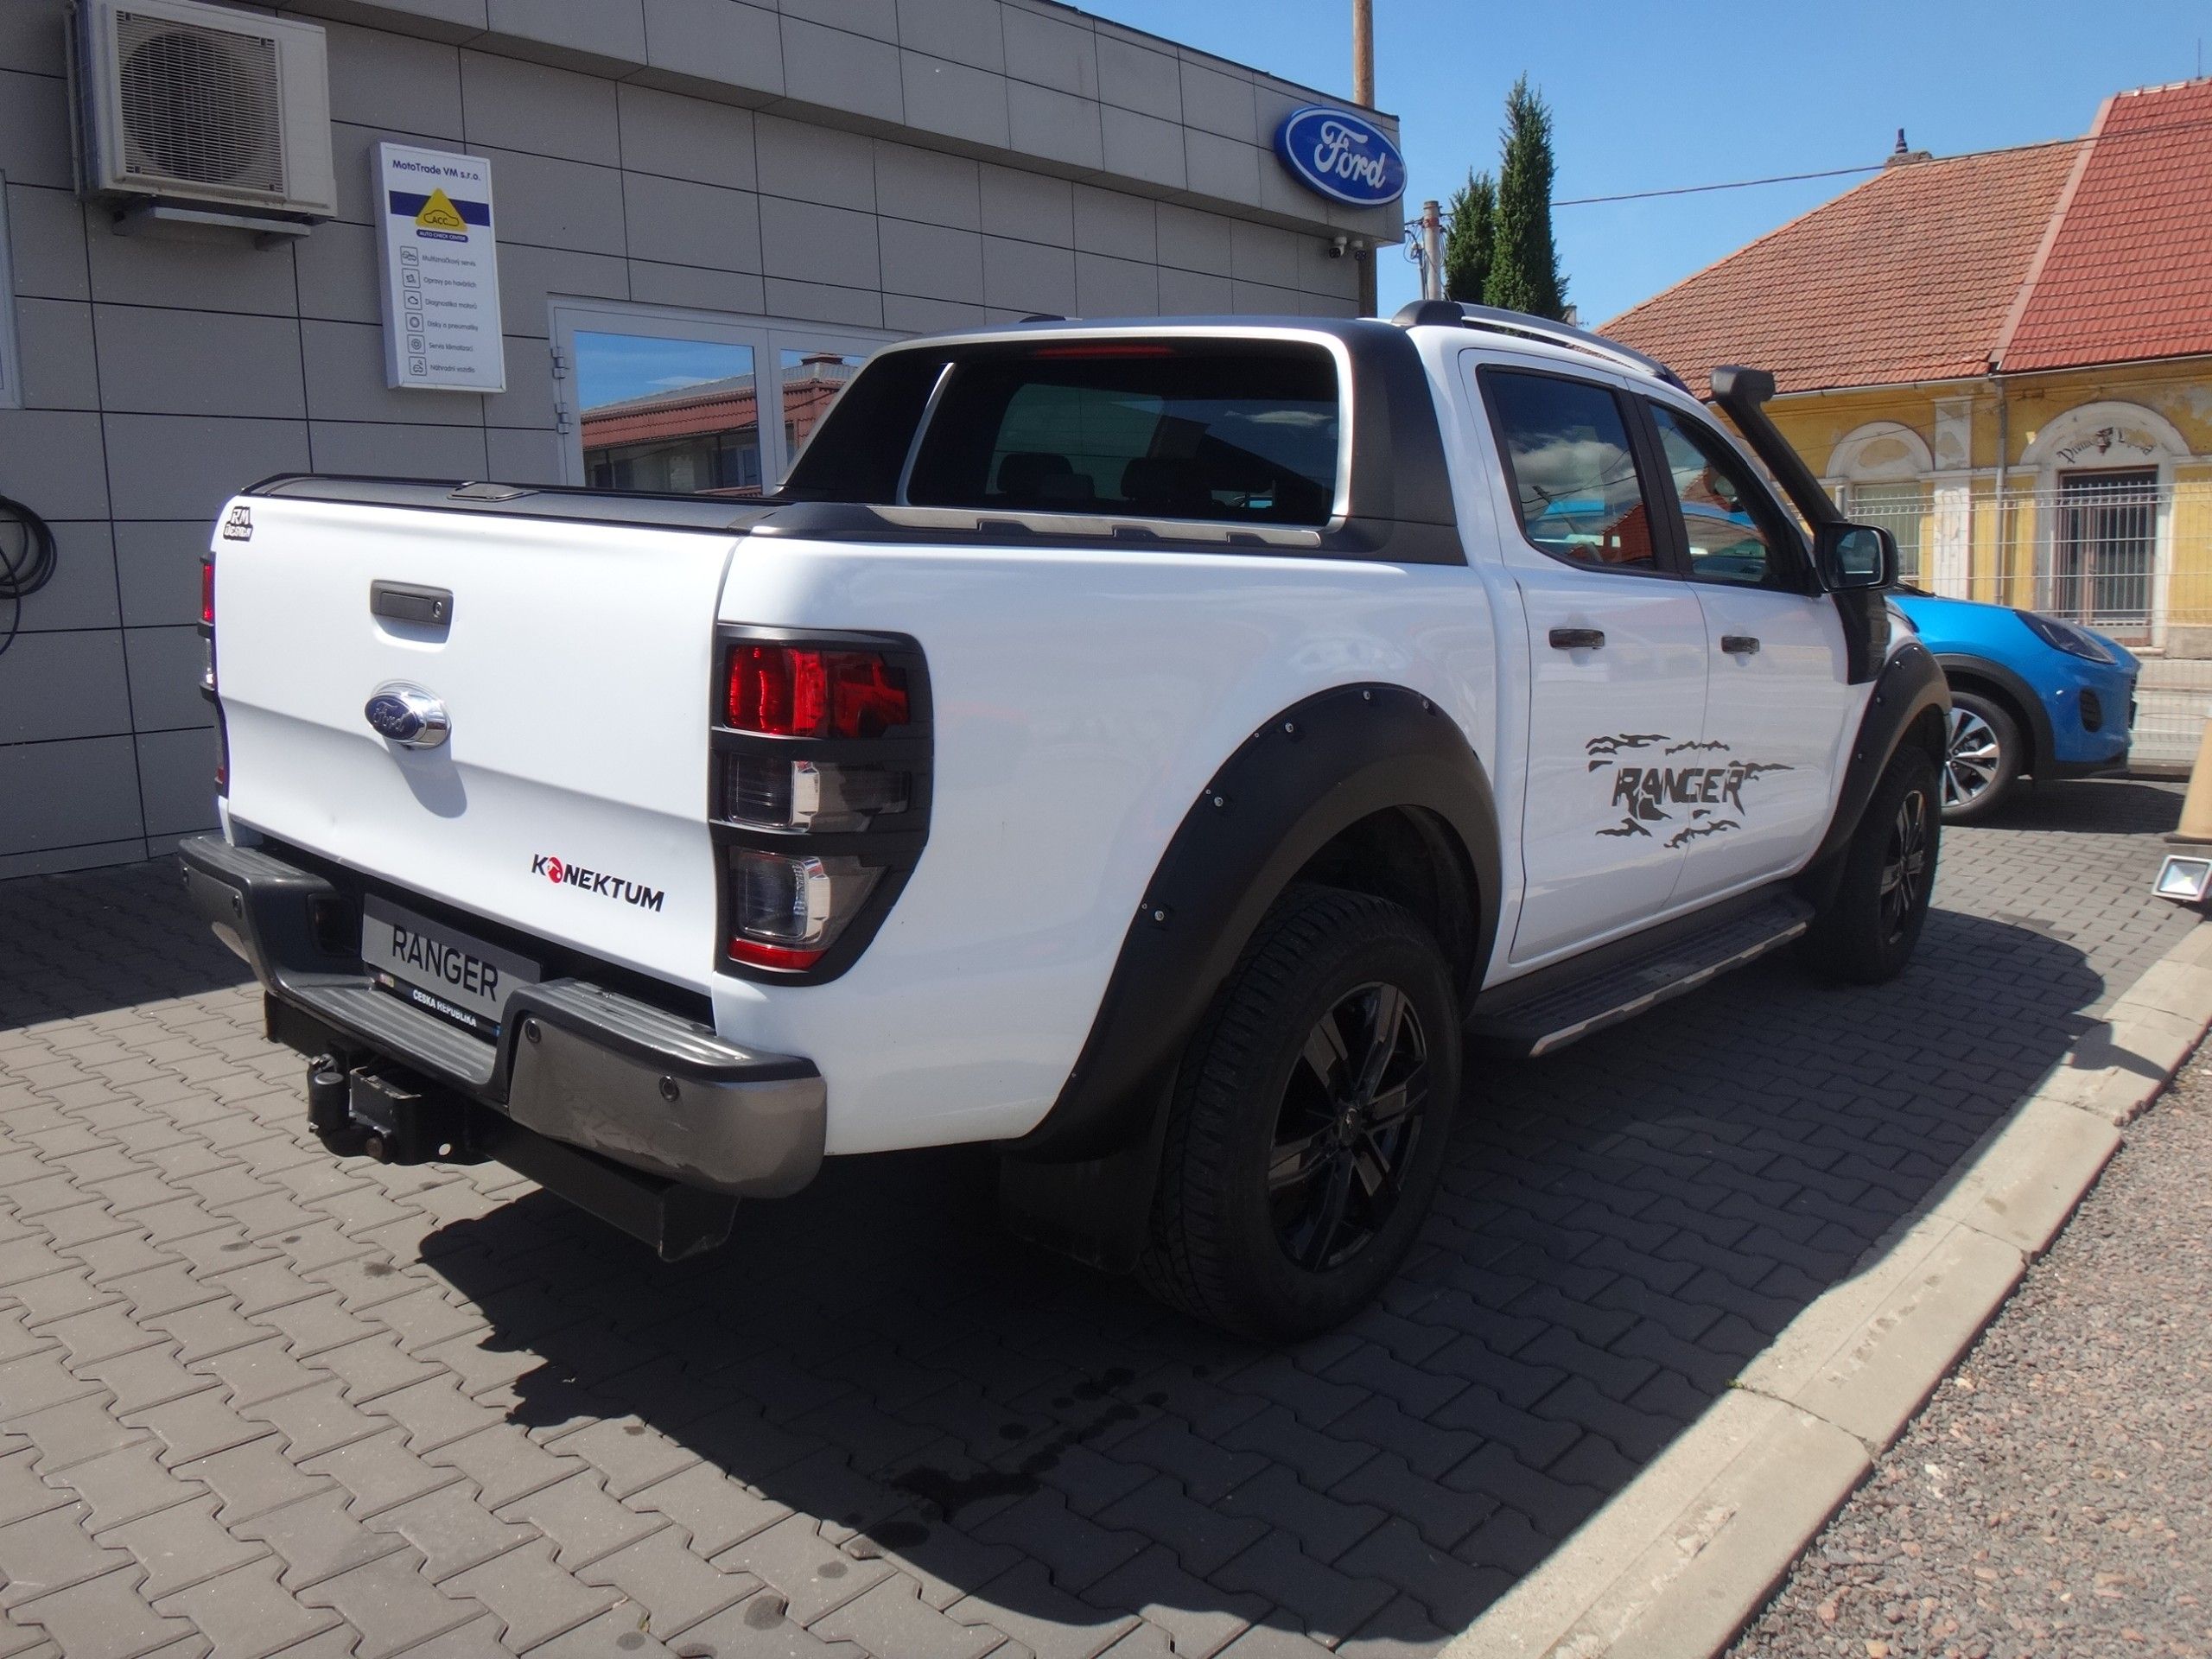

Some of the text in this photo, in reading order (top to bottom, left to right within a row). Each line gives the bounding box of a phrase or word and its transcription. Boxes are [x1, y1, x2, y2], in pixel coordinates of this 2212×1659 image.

[1314, 120, 1386, 188] Ford
[392, 160, 481, 181] MotoTrade VM s.r.o.
[433, 217, 449, 226] ACC
[423, 276, 443, 286] Opravy
[425, 298, 457, 308] Diagnostika
[373, 700, 412, 733] Ford
[1612, 767, 1745, 820] RANGER
[531, 854, 665, 912] KONEKTUM
[392, 924, 499, 1002] RANGER
[437, 1001, 477, 1027] REPUBLIKA
